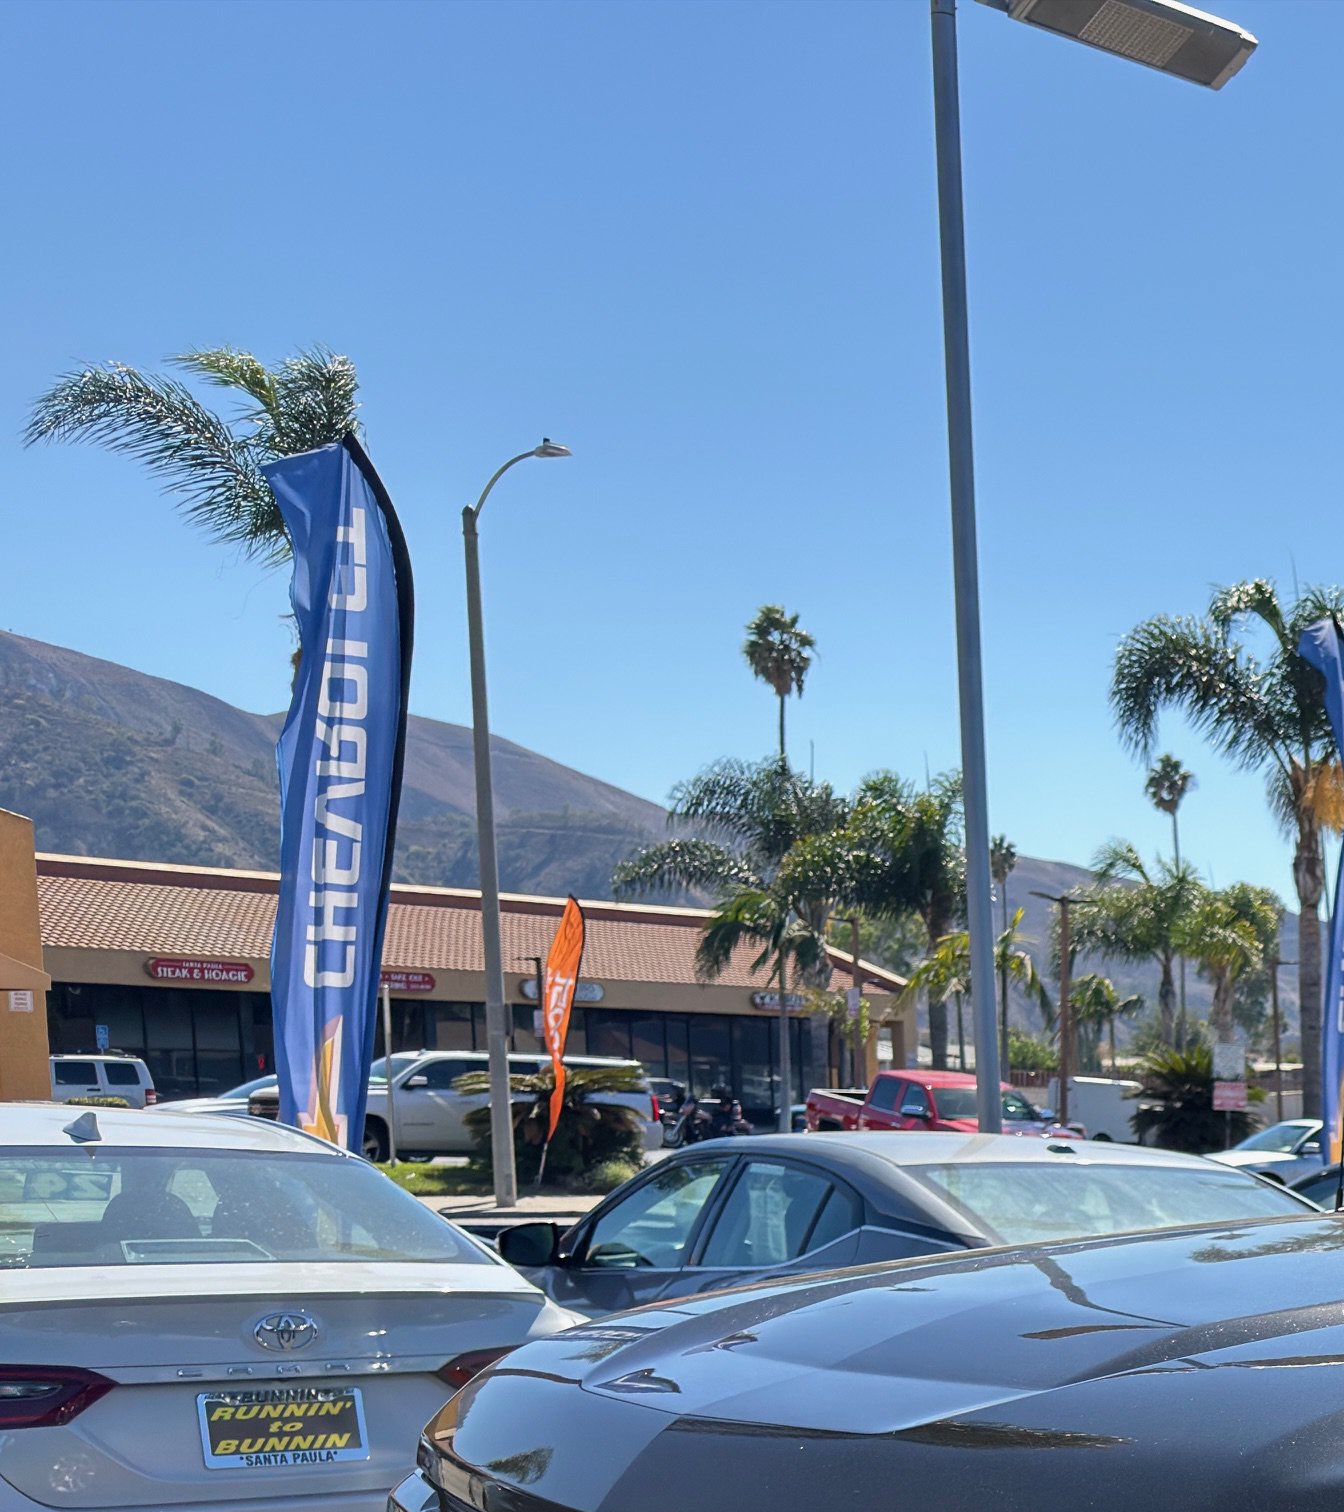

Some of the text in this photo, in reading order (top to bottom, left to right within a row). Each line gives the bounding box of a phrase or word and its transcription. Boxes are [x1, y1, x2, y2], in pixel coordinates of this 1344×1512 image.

[157, 966, 249, 982] STEAK & HOAGIE
[210, 1401, 354, 1421] RUNNIN'
[268, 1421, 304, 1433] to
[214, 1433, 352, 1455] BUNNIN
